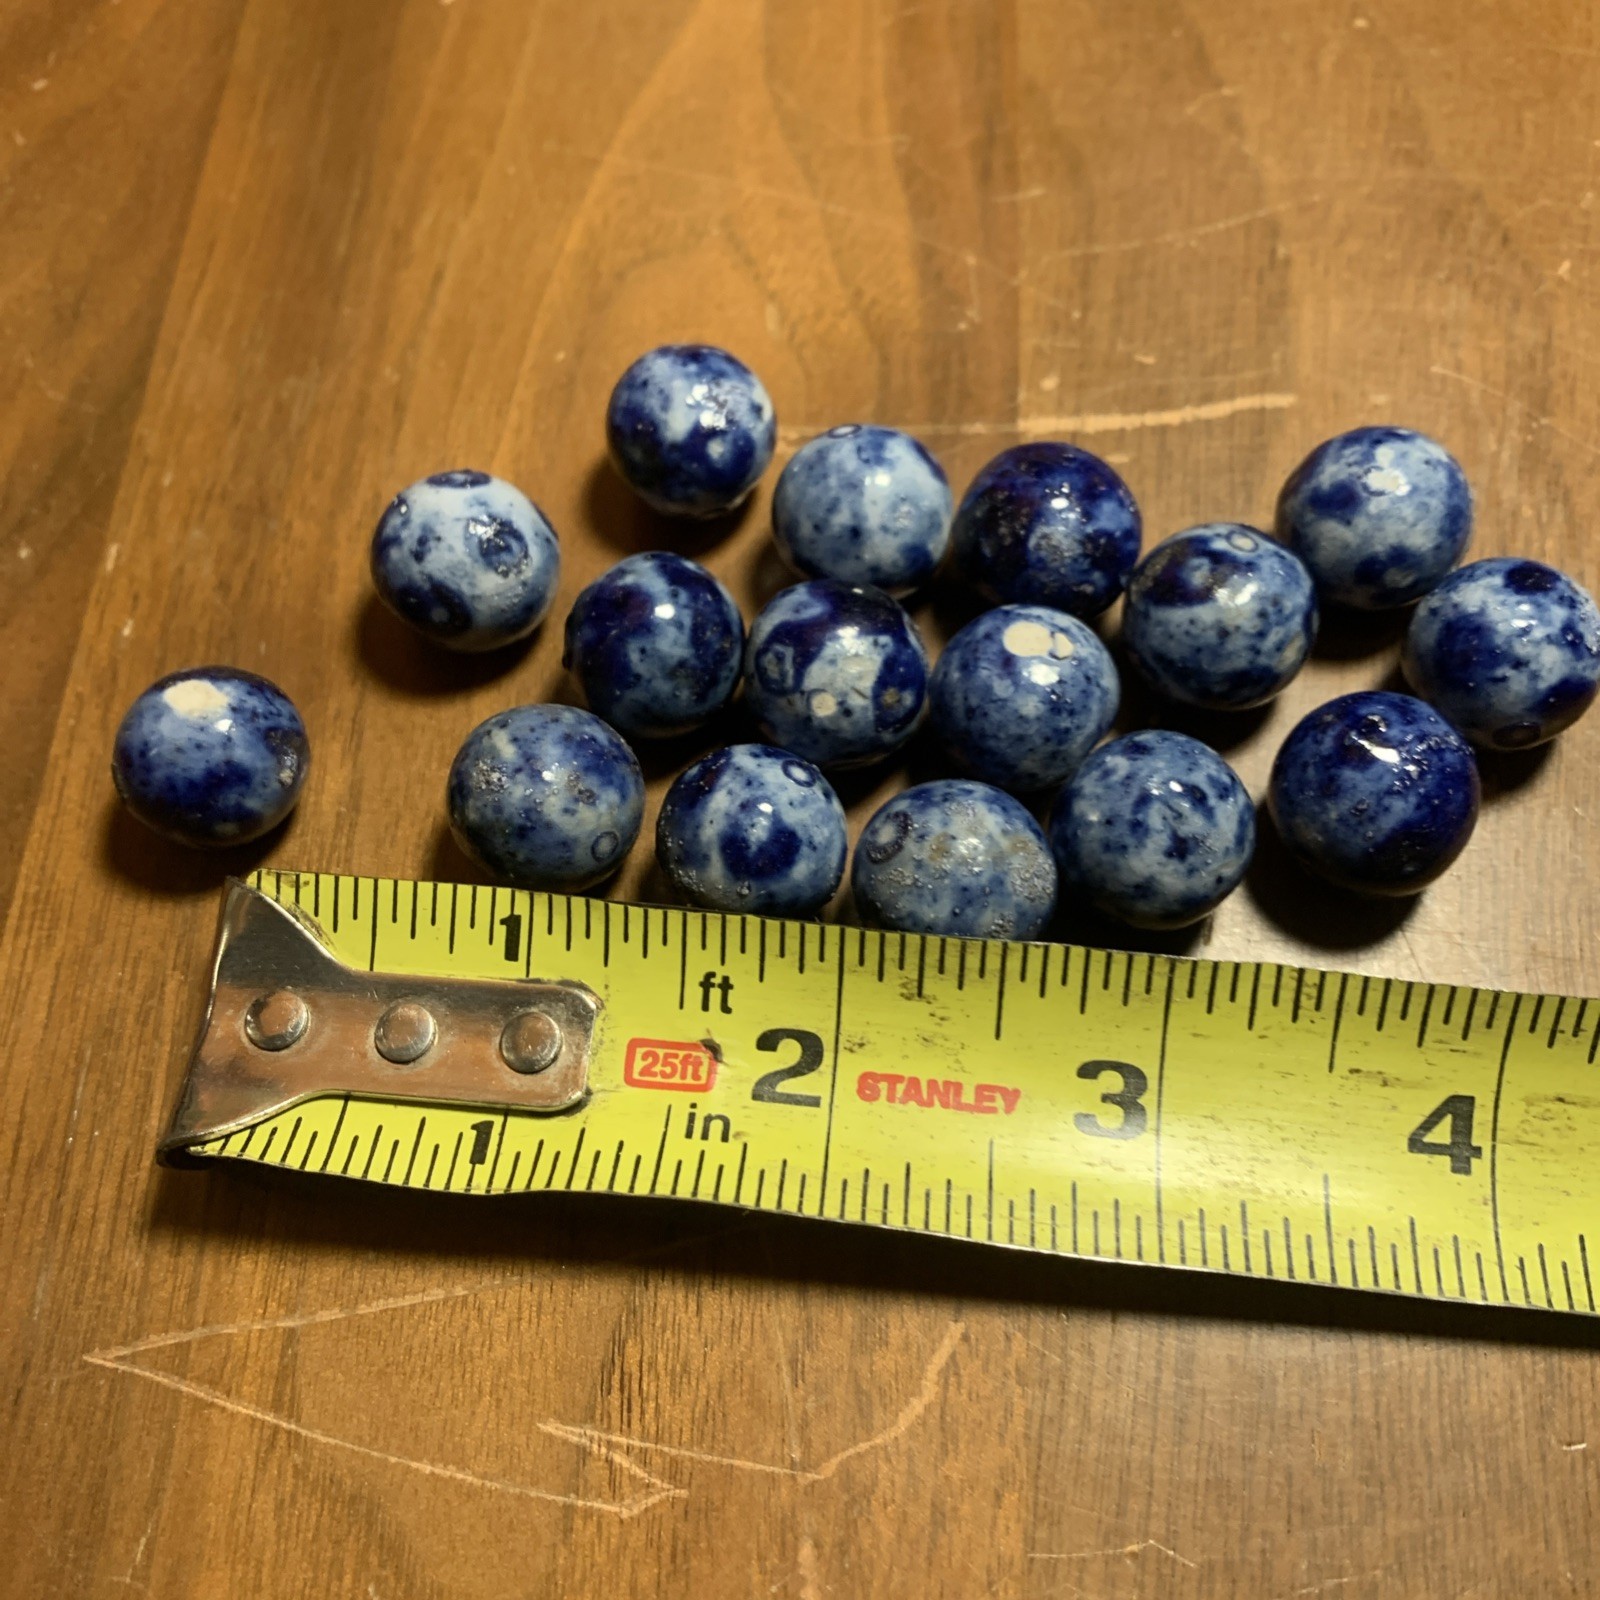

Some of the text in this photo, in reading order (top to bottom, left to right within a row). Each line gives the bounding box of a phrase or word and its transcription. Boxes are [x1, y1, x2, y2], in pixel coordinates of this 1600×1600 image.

[499, 914, 522, 962] 1
[698, 971, 734, 1014] ft
[638, 1050, 704, 1082] 25ft
[751, 1028, 824, 1108] 2
[856, 1071, 1021, 1115] STANLEY
[1073, 1060, 1148, 1140] 3
[469, 1120, 495, 1165] 1
[685, 1103, 731, 1142] in
[1407, 1094, 1483, 1175] 4
